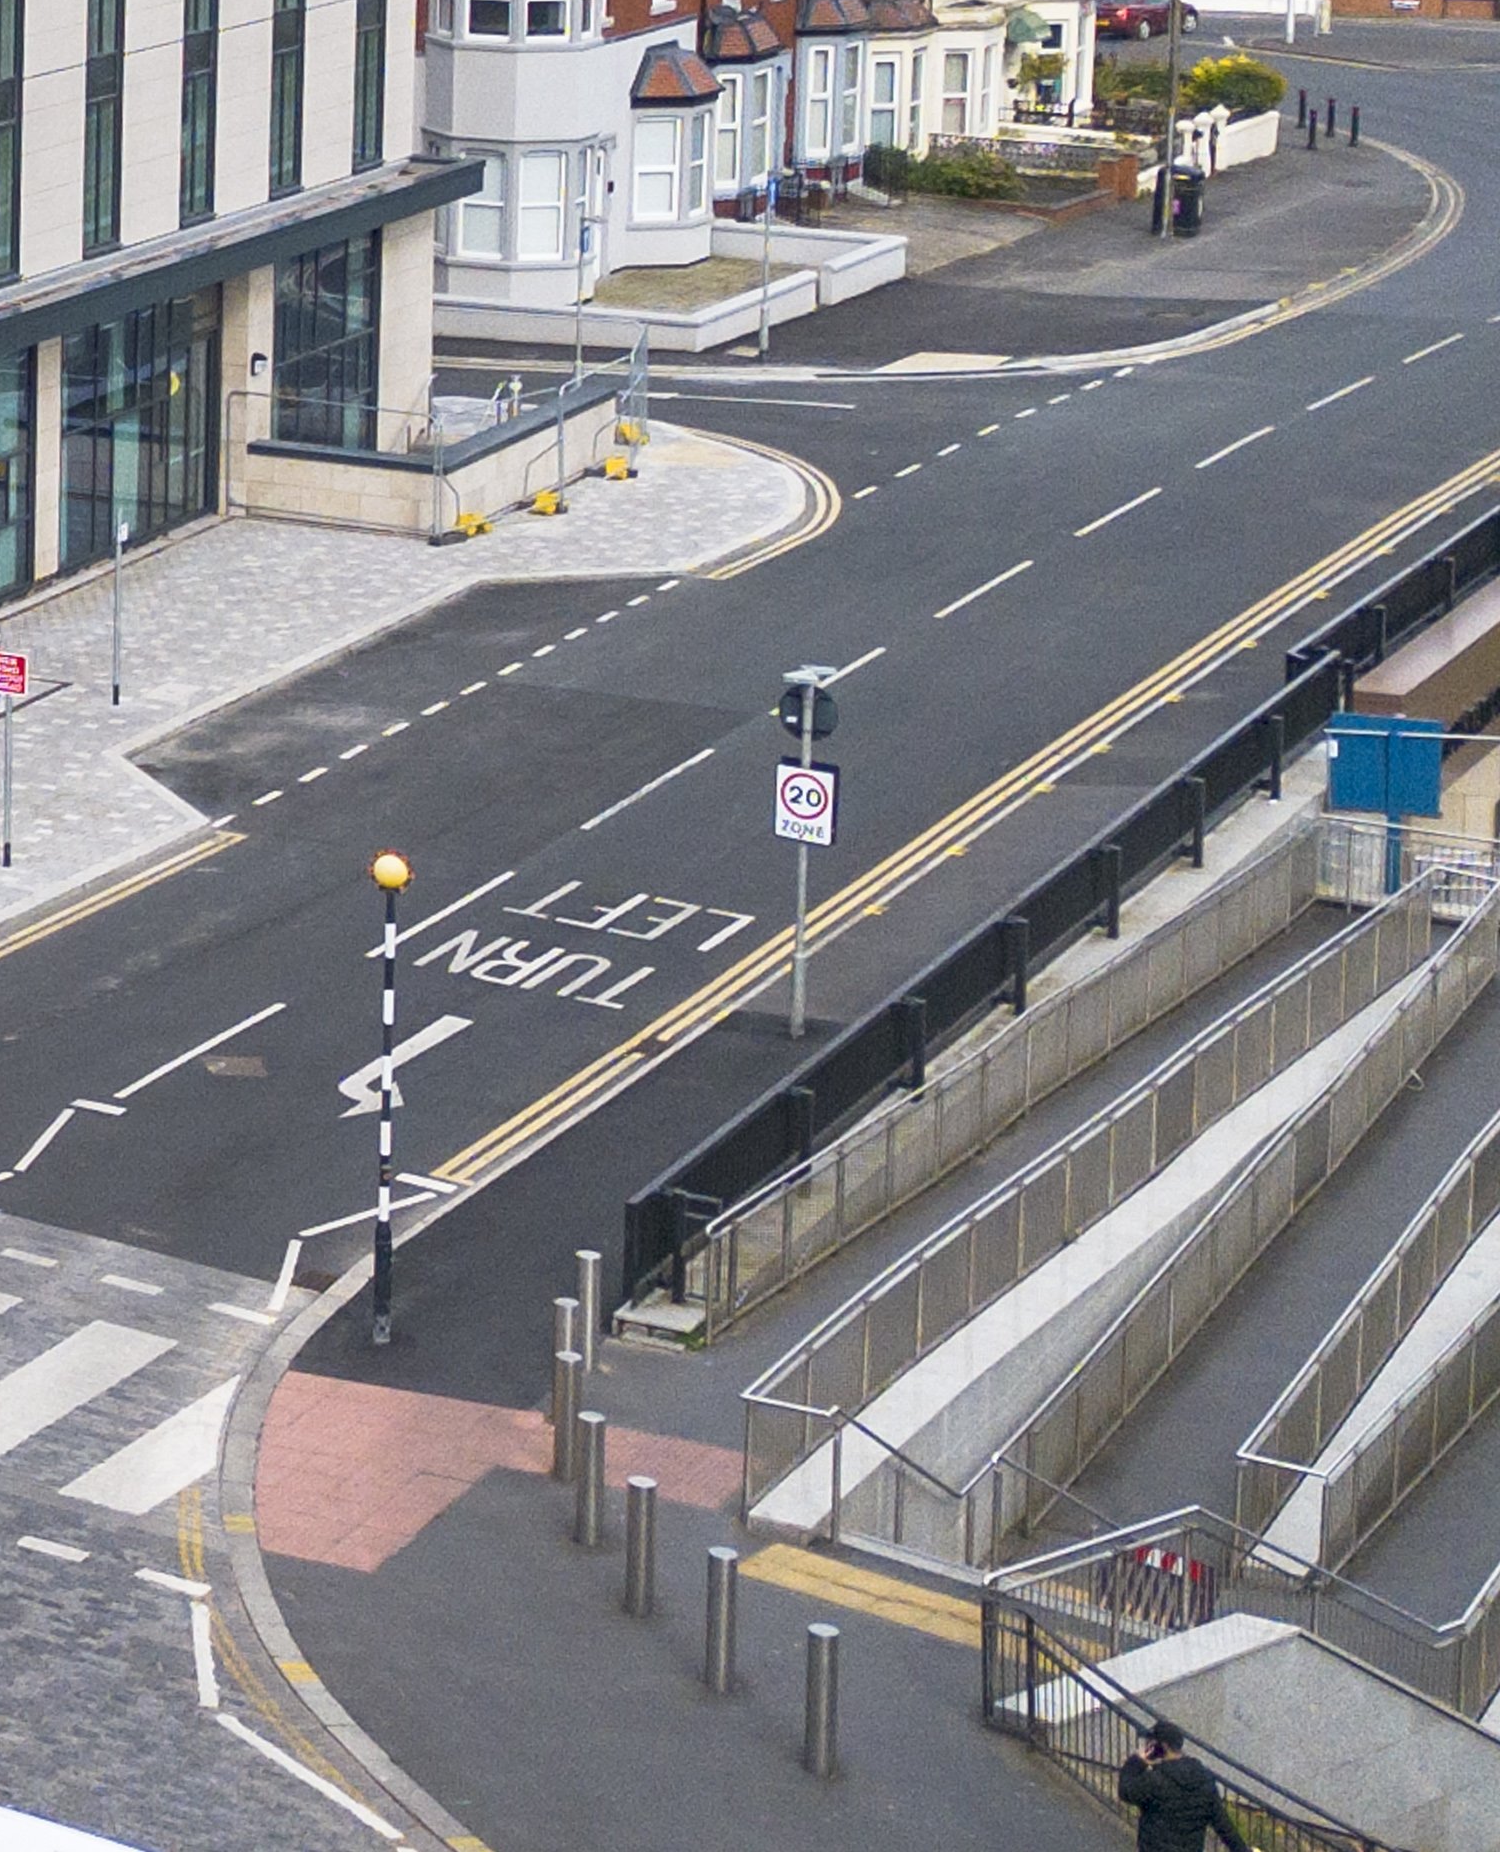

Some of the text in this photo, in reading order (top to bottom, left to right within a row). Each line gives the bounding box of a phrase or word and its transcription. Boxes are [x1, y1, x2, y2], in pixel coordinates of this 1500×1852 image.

[789, 785, 822, 807] 20
[781, 819, 825, 839] ZONE
[502, 880, 755, 952] LEFT
[412, 929, 656, 1010] TURN
